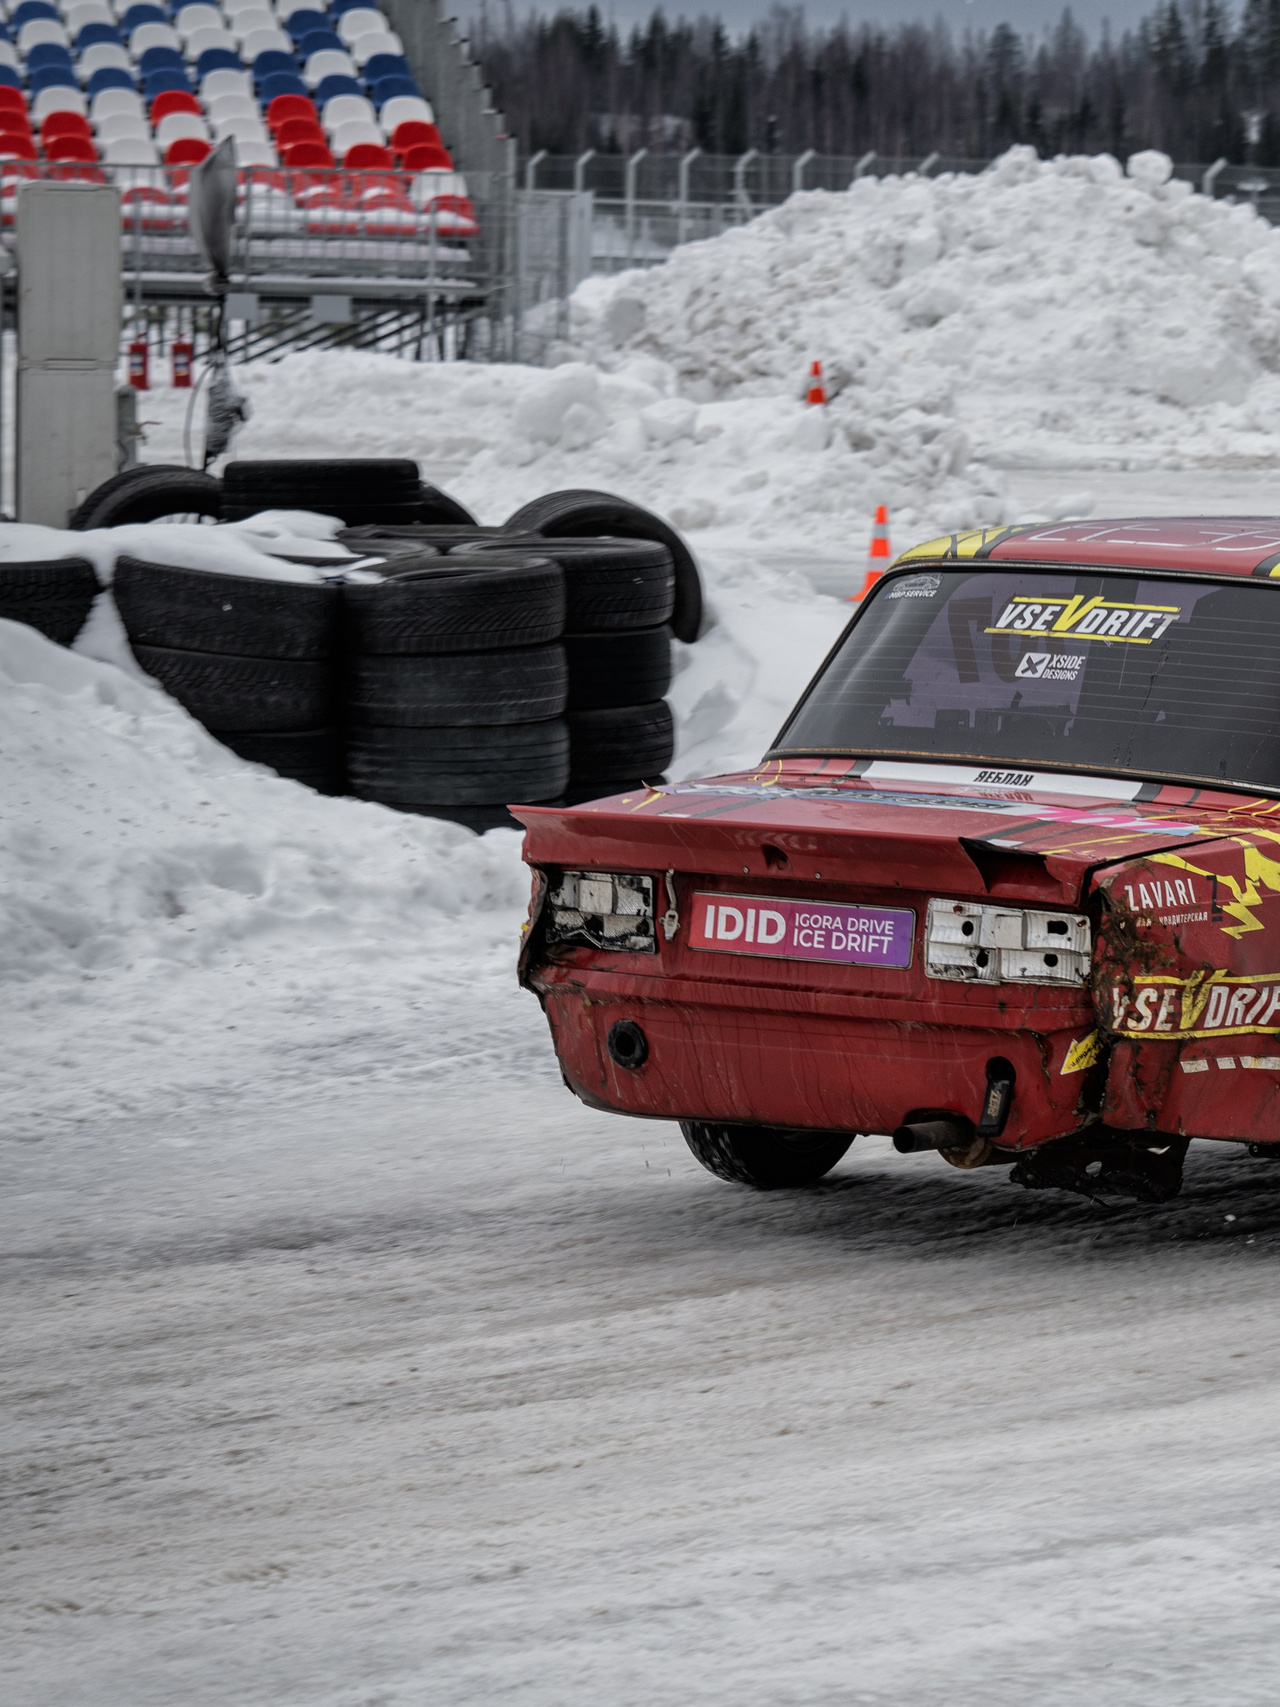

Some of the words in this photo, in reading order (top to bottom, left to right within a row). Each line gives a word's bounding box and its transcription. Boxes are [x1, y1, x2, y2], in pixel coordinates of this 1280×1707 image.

[1049, 654, 1086, 670] XSIDE
[1042, 669, 1079, 681] DESIGNS
[1124, 878, 1197, 912] ZAVARI
[704, 904, 787, 944] IDID
[795, 912, 843, 930] IGORA
[847, 918, 895, 936] DRIVE
[793, 928, 825, 949] ICE
[831, 933, 893, 954] DRIFT
